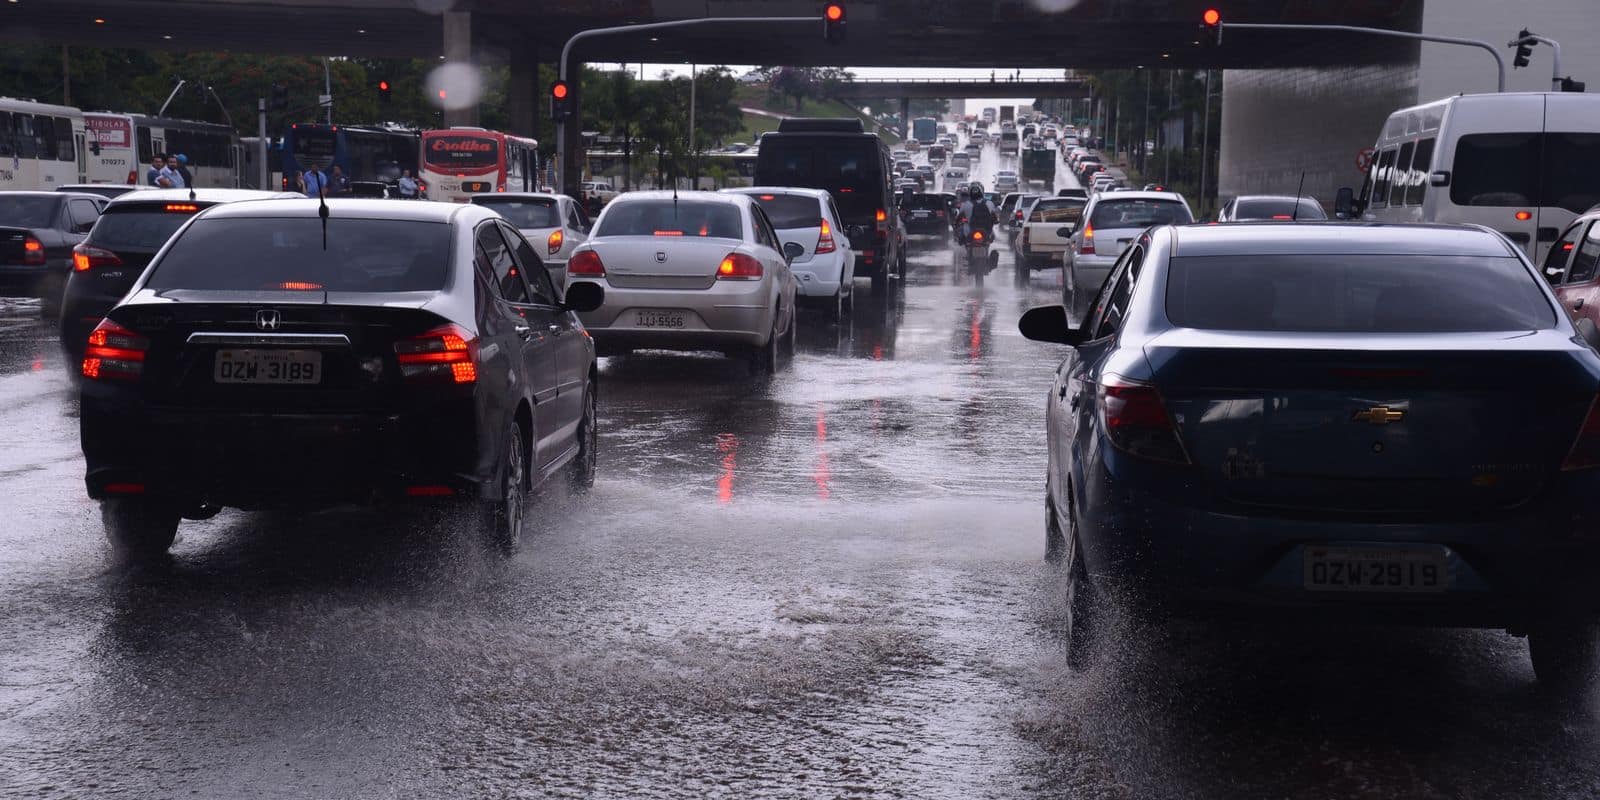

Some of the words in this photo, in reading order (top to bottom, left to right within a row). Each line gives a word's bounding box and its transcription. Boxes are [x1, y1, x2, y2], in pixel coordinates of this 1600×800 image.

[432, 140, 492, 152] Erotika
[221, 361, 314, 380] OZW-3189
[1312, 561, 1437, 587] OZW-2919
